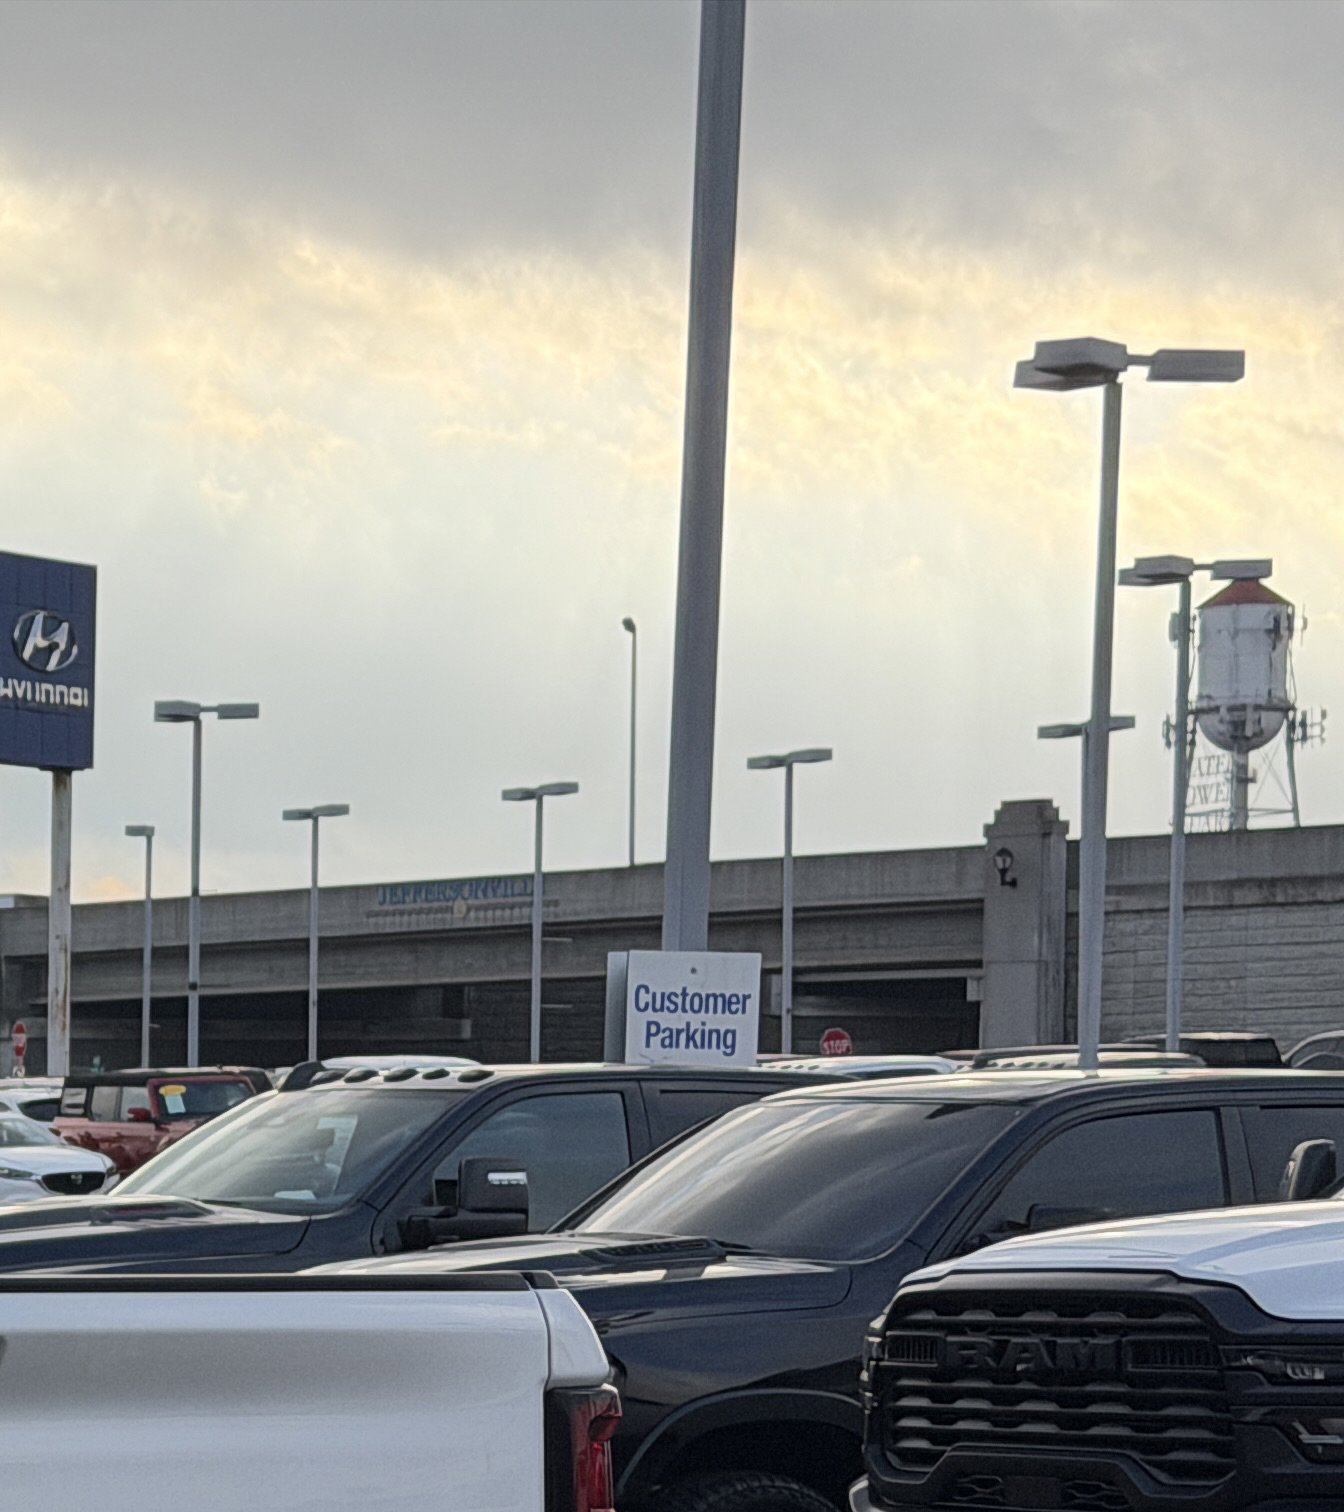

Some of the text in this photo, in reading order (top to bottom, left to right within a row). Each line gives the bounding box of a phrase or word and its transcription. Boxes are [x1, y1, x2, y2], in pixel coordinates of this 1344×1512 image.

[377, 876, 544, 906] JEFFERSONVILL
[634, 983, 752, 1015] Customer
[644, 1020, 737, 1057] Parking
